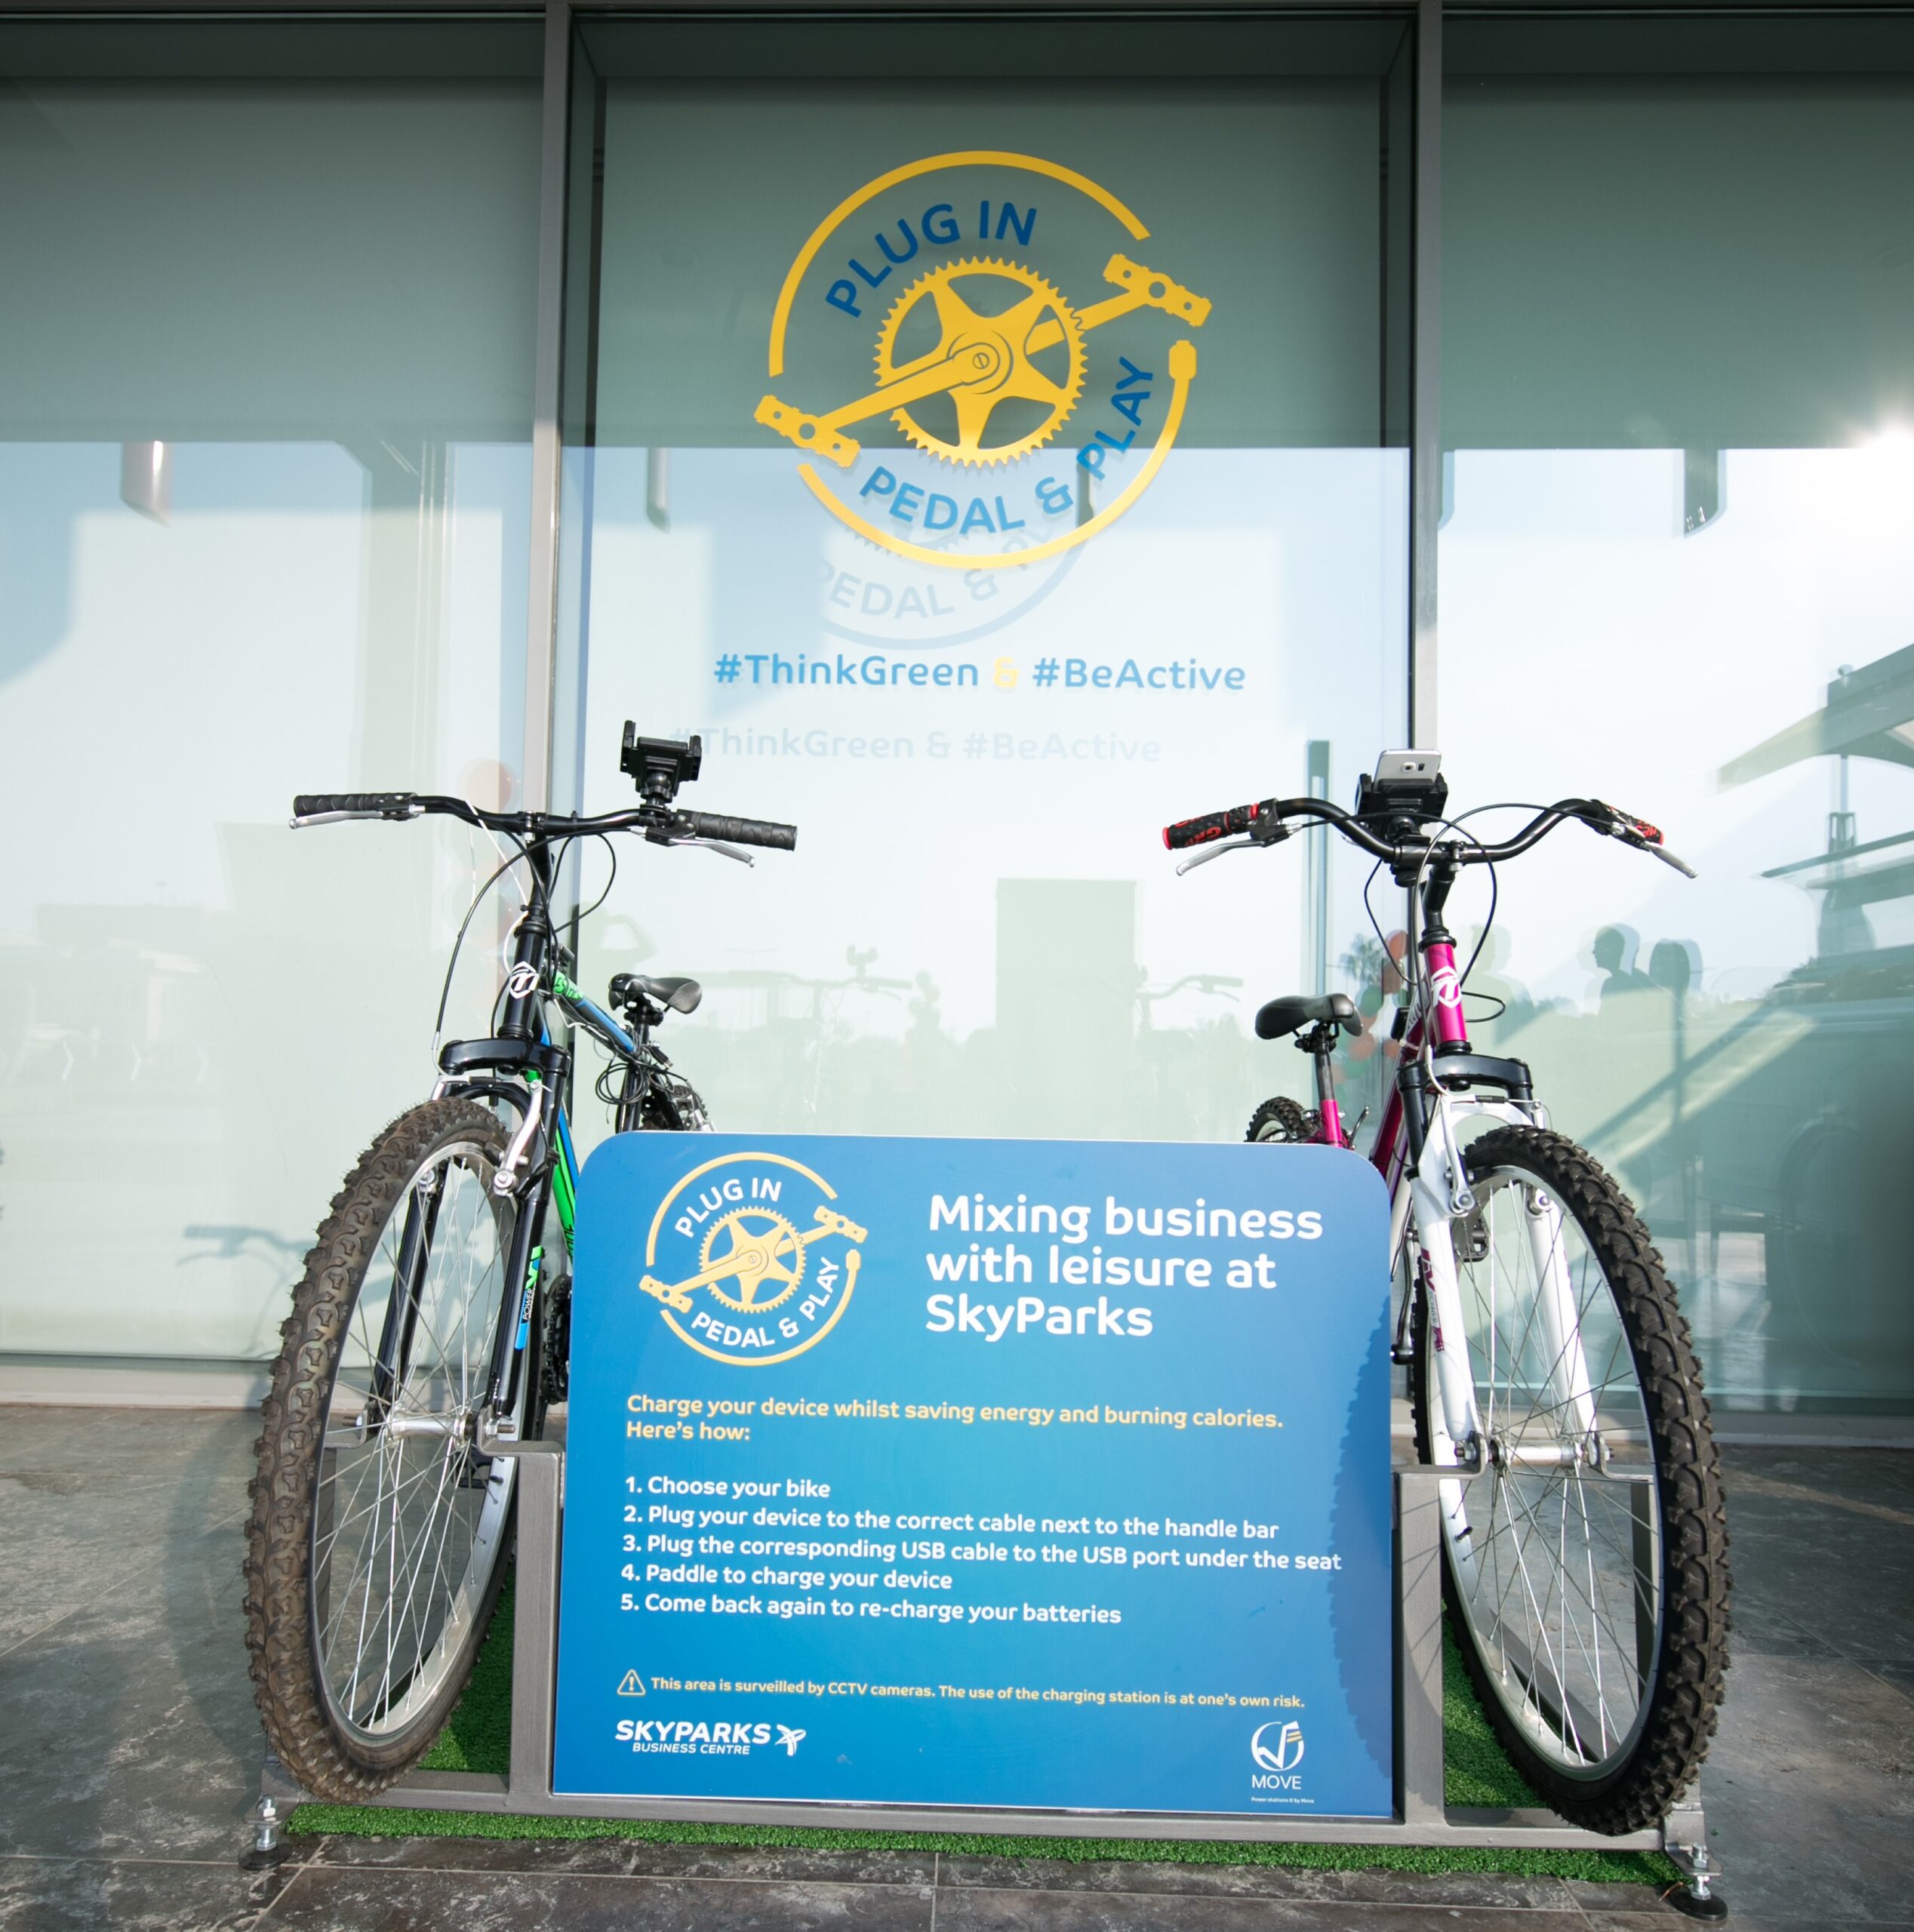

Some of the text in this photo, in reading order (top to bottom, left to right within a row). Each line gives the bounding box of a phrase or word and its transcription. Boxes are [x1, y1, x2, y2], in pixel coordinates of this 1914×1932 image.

[826, 201, 1037, 318] PLUG IN
[859, 355, 1154, 534] PEDAL & PLAY
[714, 654, 1246, 690] #ThinkGreen & #BeActive
[675, 1177, 782, 1238] PLUG IN
[930, 1193, 1322, 1244] Mixing business
[926, 1243, 1276, 1288] with leisure at
[691, 1257, 840, 1348] PEDAL & PLAY
[926, 1293, 1152, 1342] SkyParks
[627, 1394, 1283, 1429] Charge your device whilst saving energy and burning calories.
[700, 1423, 749, 1441] how:
[626, 1475, 830, 1500] 1. Choose your bike
[623, 1505, 1279, 1538] 2. Plug your device to the correct cable next to the handle bar
[623, 1534, 1342, 1570] 3. Plug the corresponding USB cable to the USB port under the seat
[621, 1564, 952, 1590] 4. Paddle to charge your device
[620, 1593, 1122, 1623] 5. Come back again to re-charge your batteries
[651, 1677, 682, 1690] This
[685, 1680, 716, 1692] area
[719, 1678, 732, 1692] is
[734, 1680, 805, 1694] surveilled
[808, 1681, 826, 1697] by
[828, 1681, 868, 1696] CCTV
[870, 1685, 935, 1697] cameras.
[939, 1684, 965, 1699] The
[969, 1688, 994, 1700] use
[997, 1687, 1013, 1700] of
[1015, 1687, 1039, 1700] the
[1042, 1688, 1106, 1703] charging
[1109, 1690, 1160, 1703] station
[1165, 1691, 1176, 1704] is
[1180, 1694, 1194, 1705] at
[1240, 1697, 1269, 1706] own
[1274, 1695, 1304, 1707] risk.
[615, 1719, 771, 1744] SKYPARKS
[632, 1743, 751, 1755] BUSINESS CENTRE
[1252, 1775, 1301, 1789] MOVE
